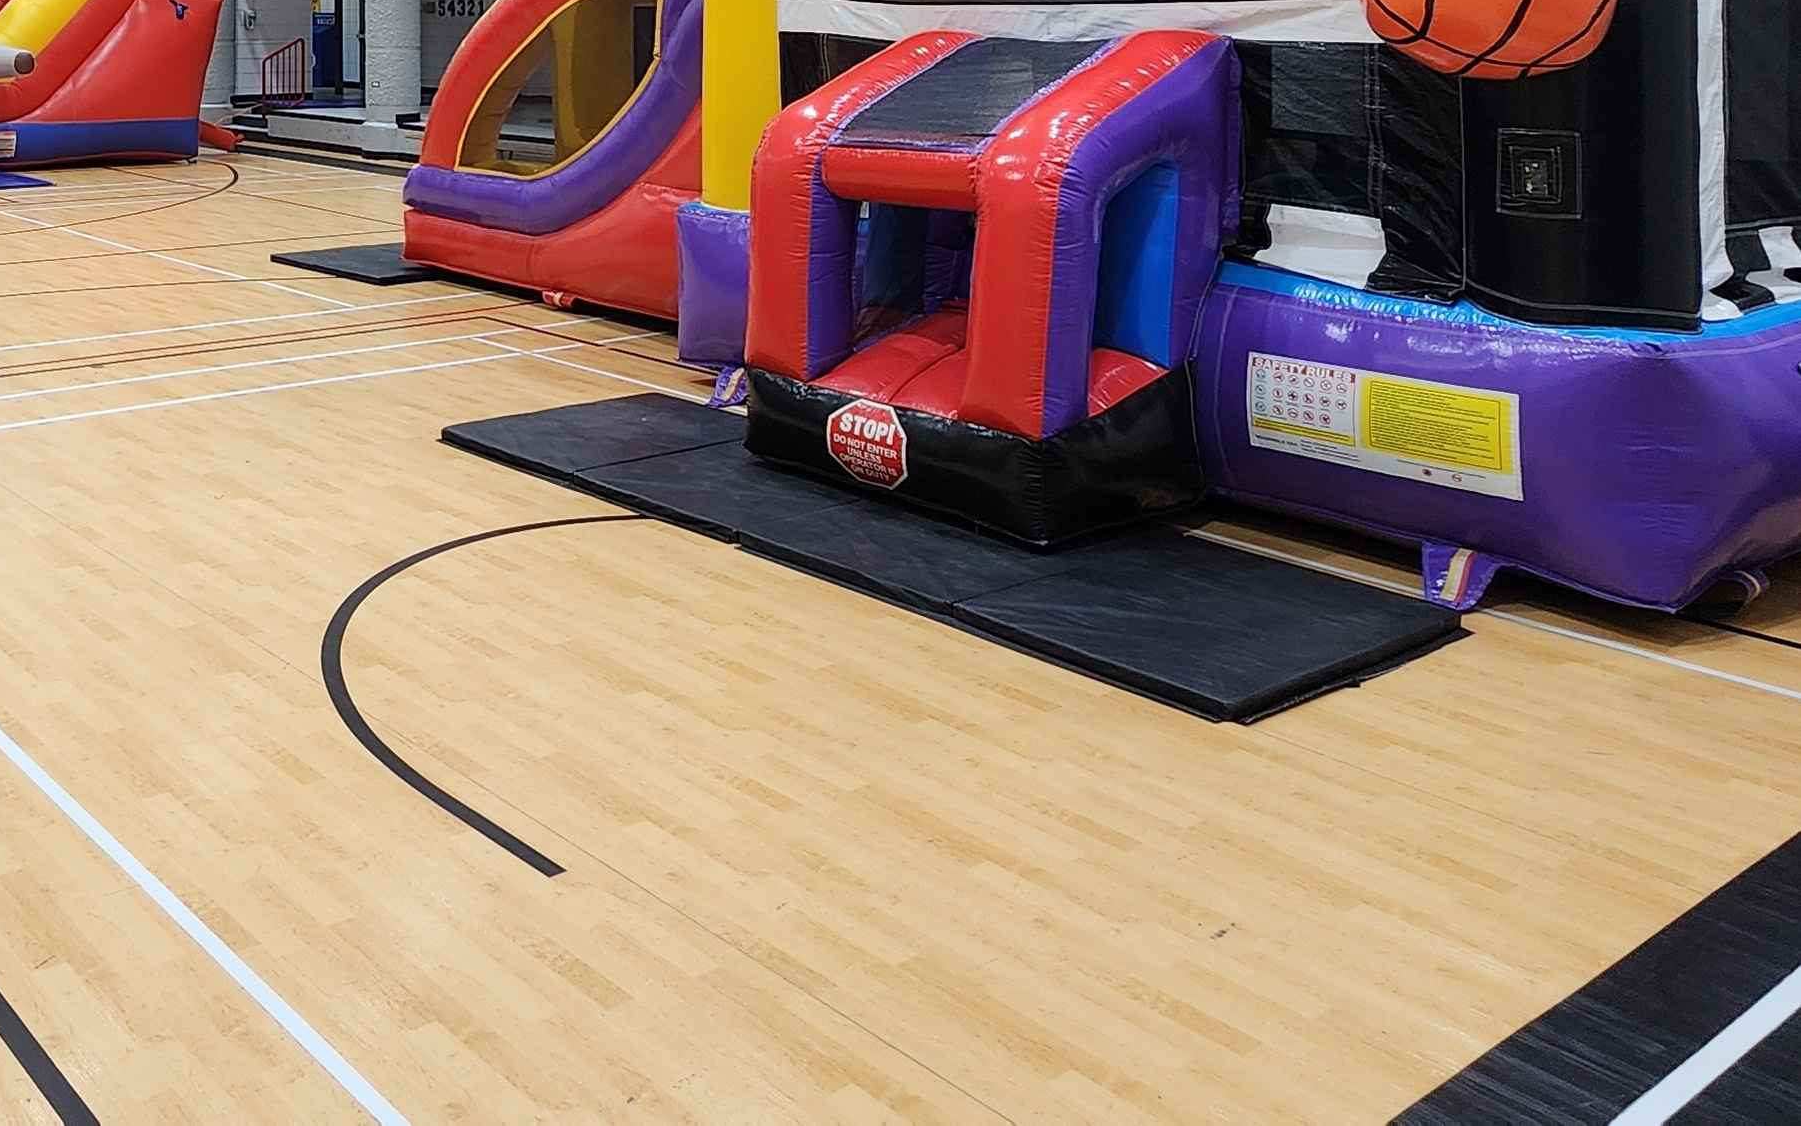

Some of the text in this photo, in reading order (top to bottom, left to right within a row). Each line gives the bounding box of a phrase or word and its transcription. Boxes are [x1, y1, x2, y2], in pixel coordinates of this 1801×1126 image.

[438, 0, 484, 17] 54321
[1253, 357, 1356, 384] SAFETY RULES
[839, 413, 896, 445] STOP!
[833, 433, 898, 459] DO NOT ENTER
[847, 447, 883, 465] UNLESS
[839, 453, 887, 474] OPERATOR
